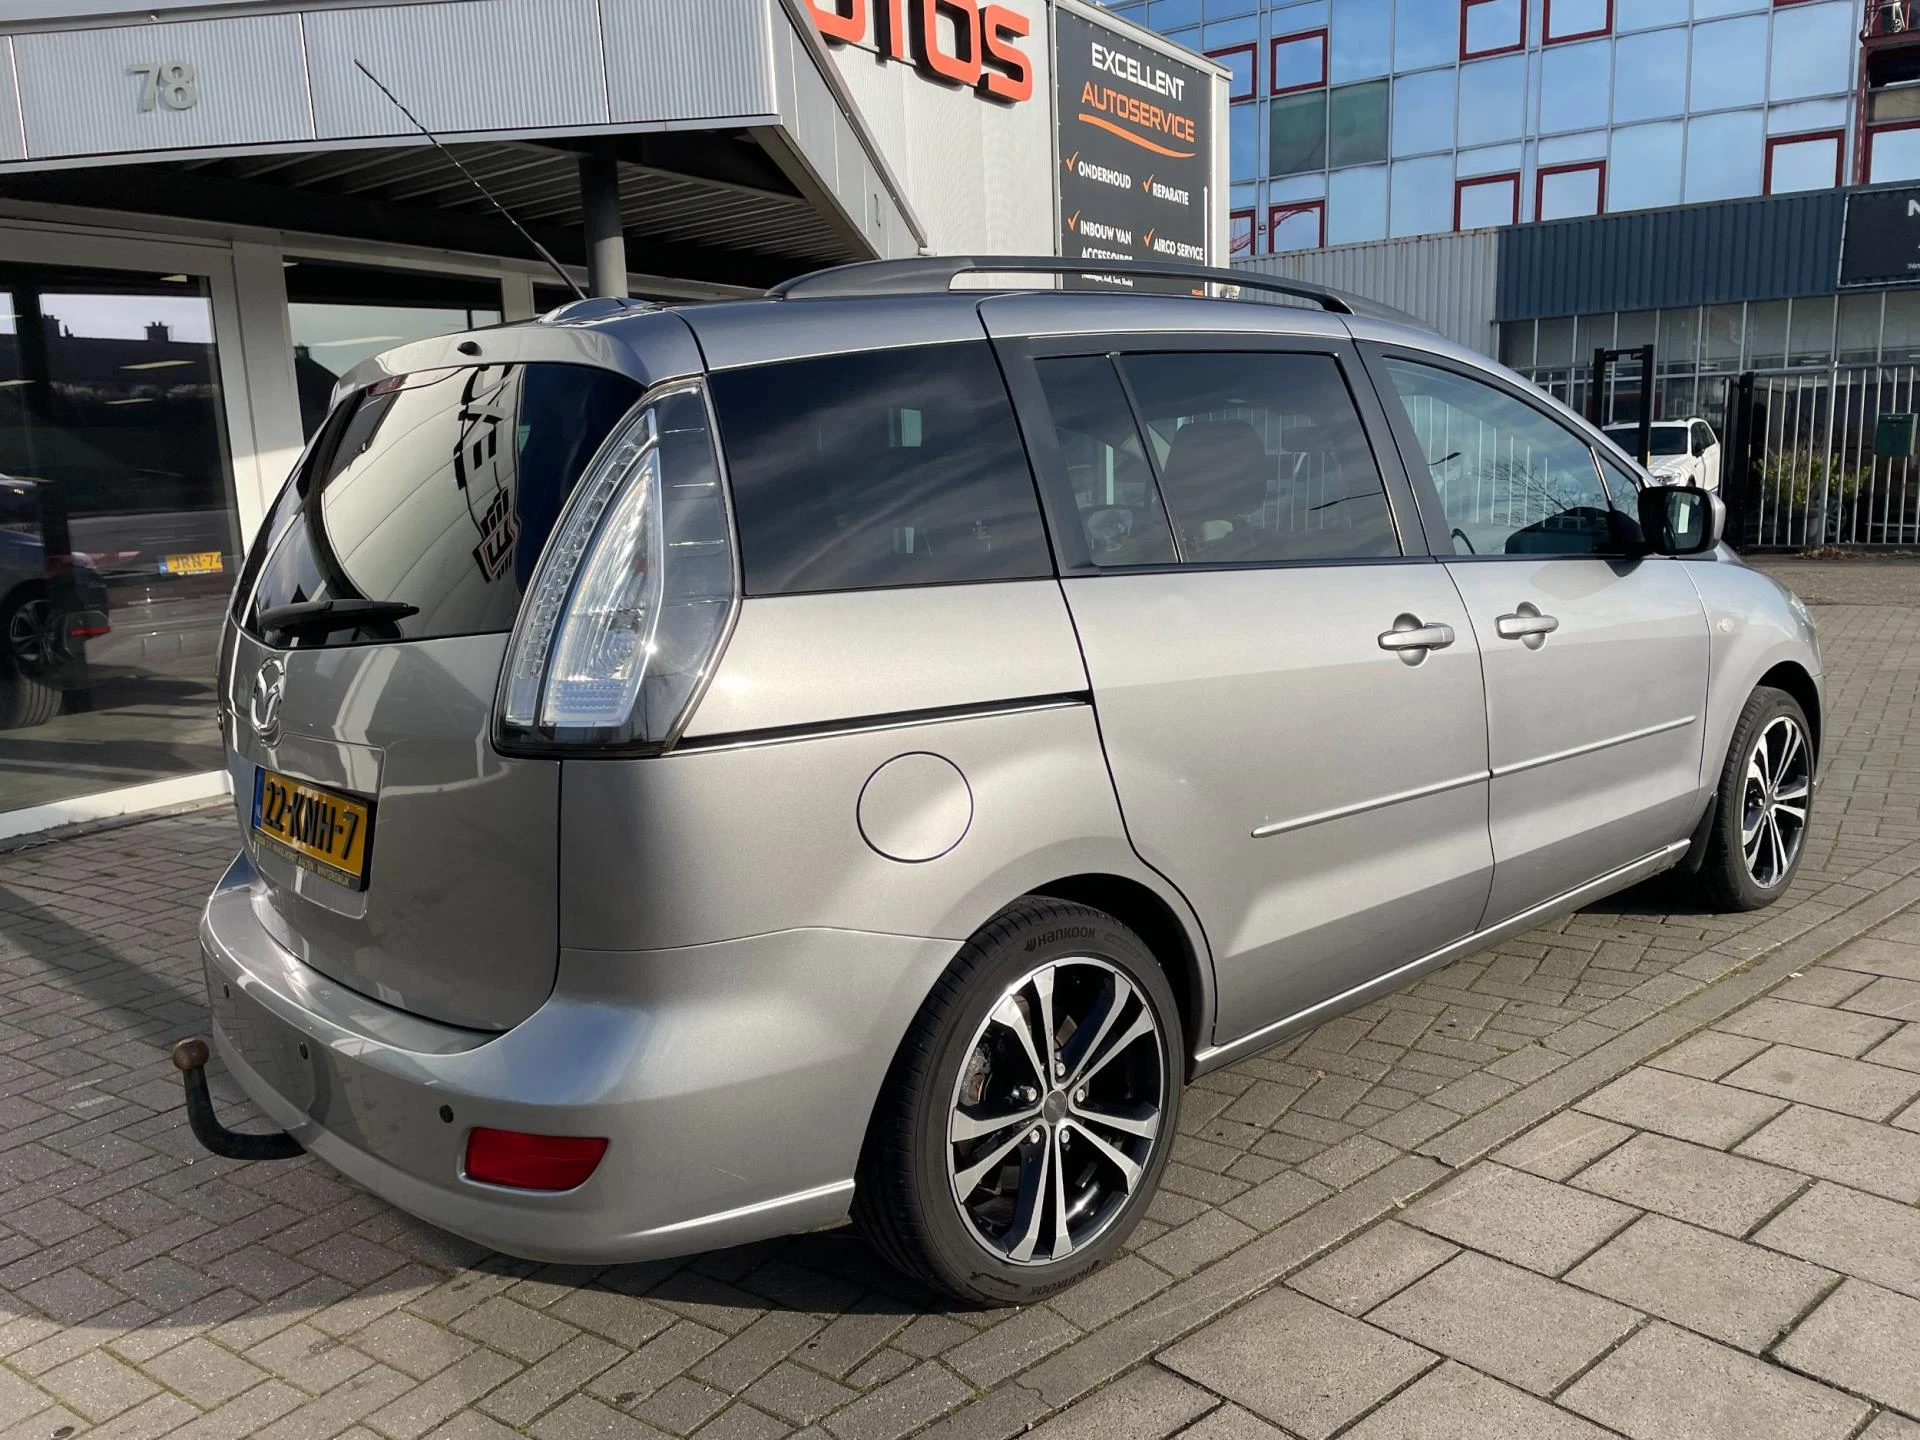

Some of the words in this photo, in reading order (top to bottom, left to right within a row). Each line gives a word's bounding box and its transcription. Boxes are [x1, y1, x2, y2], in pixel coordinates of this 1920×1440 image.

[130, 61, 197, 112] 78
[1091, 42, 1185, 102] EXCELLENT
[1081, 80, 1195, 143] AUTOSERVICE
[1077, 160, 1132, 189] ONDERHOUD
[1152, 182, 1189, 206] REPARATIE
[1080, 219, 1115, 241] INBOUW
[1115, 227, 1132, 246] VAN
[1153, 237, 1176, 255] AIRCO
[1177, 242, 1204, 261] SERVICE
[263, 781, 359, 861] 22-KNH-7
